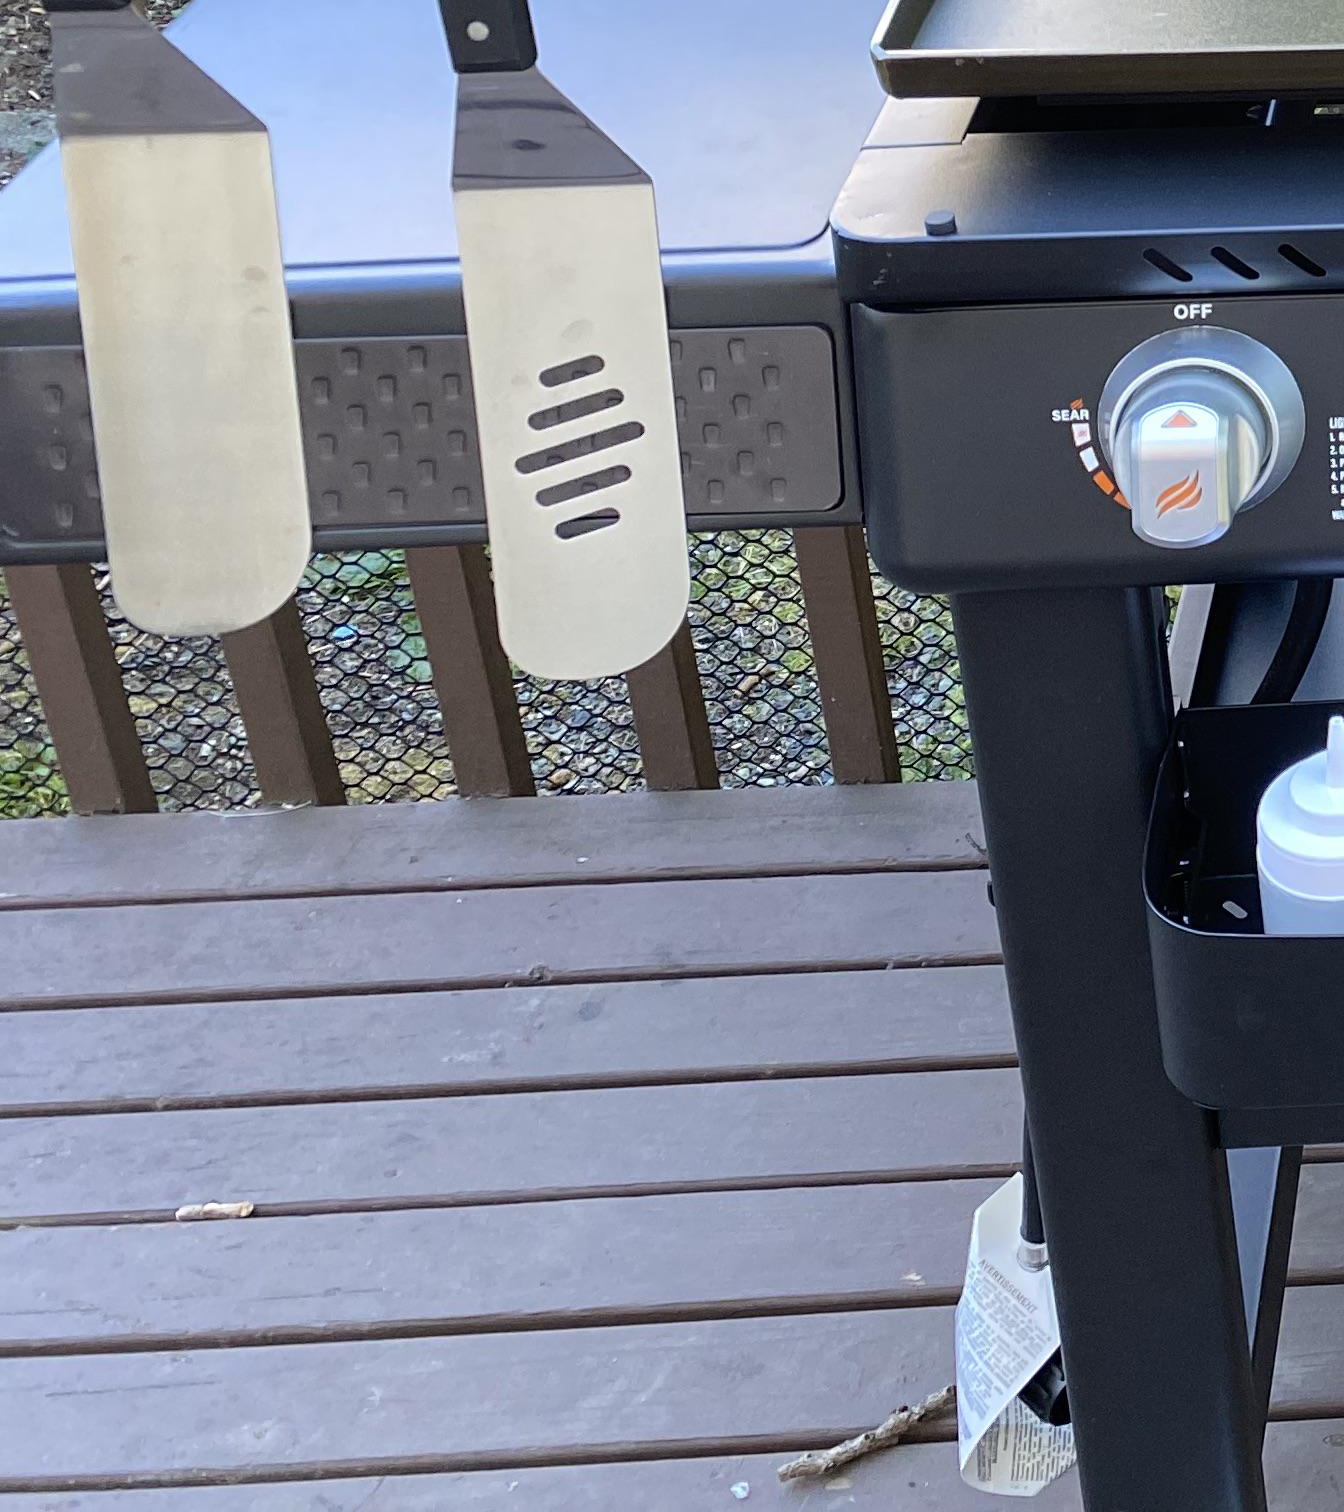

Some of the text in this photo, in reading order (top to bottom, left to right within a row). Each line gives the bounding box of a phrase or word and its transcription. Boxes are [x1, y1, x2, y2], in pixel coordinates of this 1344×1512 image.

[1173, 303, 1213, 320] OFF
[1051, 408, 1089, 422] SEAR
[979, 1258, 1038, 1313] AVERTISSEMENT
